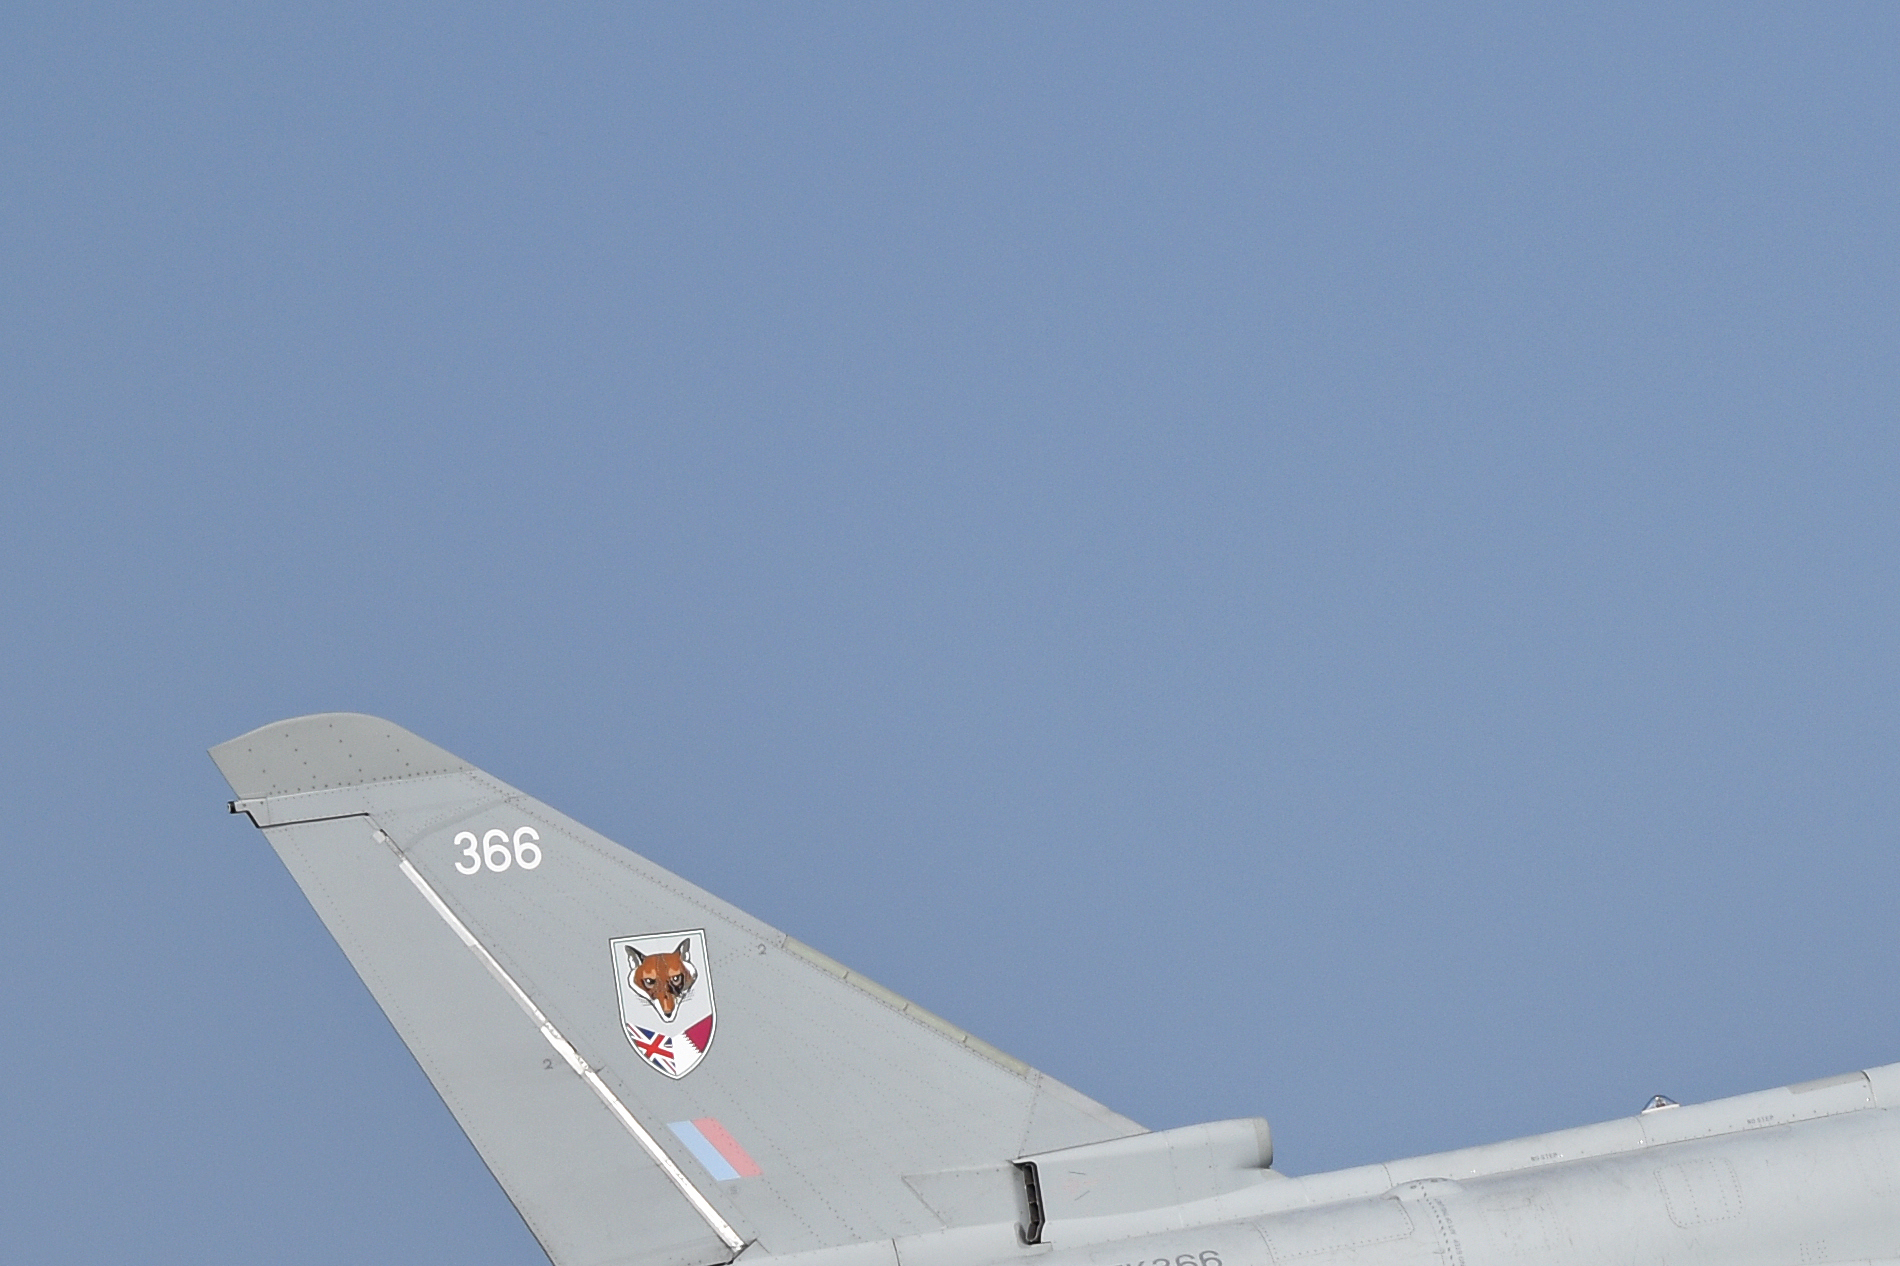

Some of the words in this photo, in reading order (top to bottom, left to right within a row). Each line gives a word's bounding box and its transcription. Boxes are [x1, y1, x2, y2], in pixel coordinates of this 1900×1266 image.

[453, 826, 542, 875] 366
[757, 943, 767, 956] 2
[542, 1058, 554, 1070] 2
